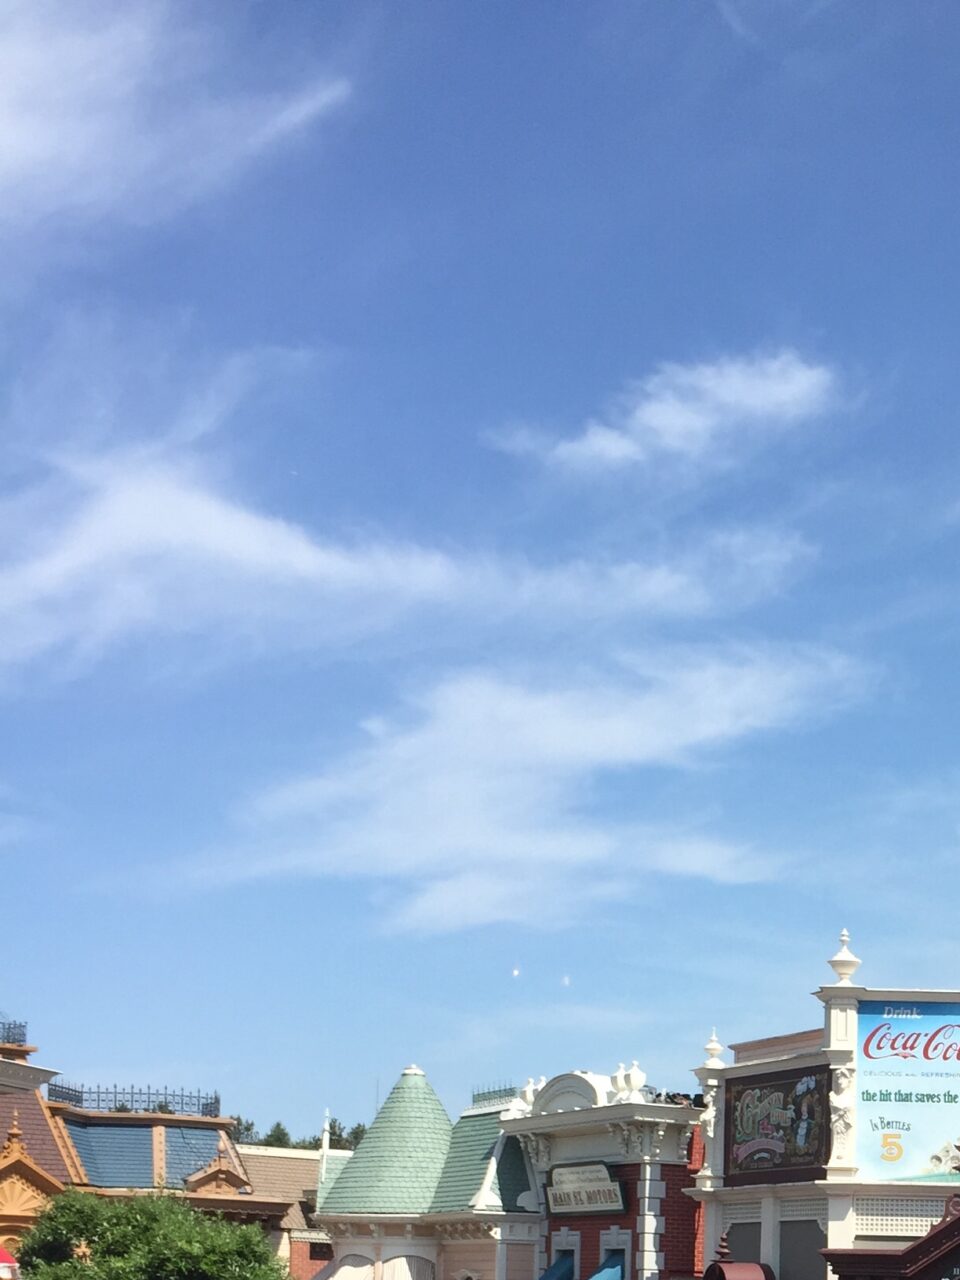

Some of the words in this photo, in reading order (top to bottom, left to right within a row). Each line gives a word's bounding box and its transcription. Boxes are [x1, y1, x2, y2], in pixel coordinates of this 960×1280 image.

[882, 1006, 922, 1018] Drink
[862, 1090, 878, 1102] the
[880, 1090, 892, 1102] hit
[894, 1090, 912, 1103] that
[915, 1092, 941, 1104] saves
[943, 1090, 958, 1104] the
[552, 1190, 572, 1206] MAIN
[586, 1188, 619, 1204] MOTORS
